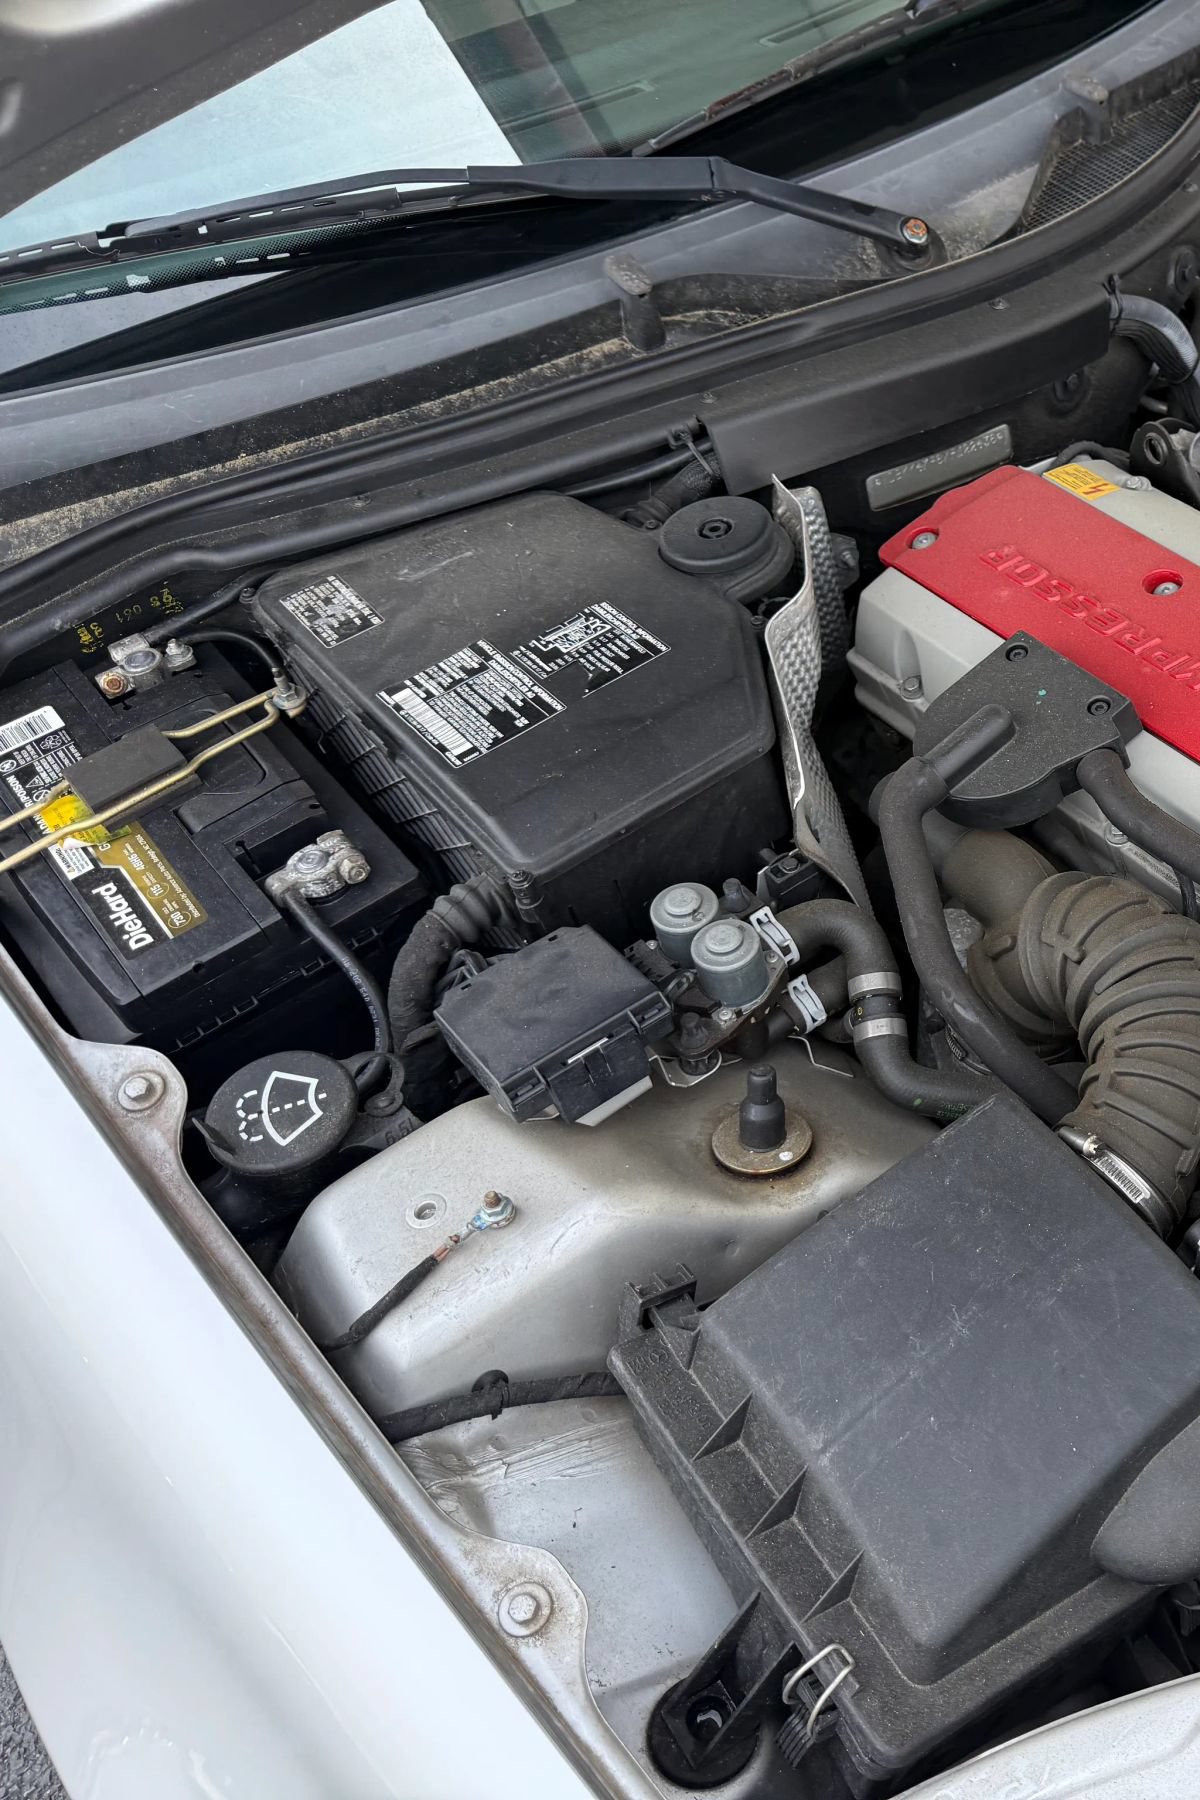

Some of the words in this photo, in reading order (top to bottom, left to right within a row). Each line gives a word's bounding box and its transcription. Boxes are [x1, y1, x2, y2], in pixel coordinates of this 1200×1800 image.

[5, 774, 48, 830] DANR/POISON
[149, 882, 164, 897] 115
[92, 882, 154, 951] DieHard
[170, 909, 186, 926] 730
